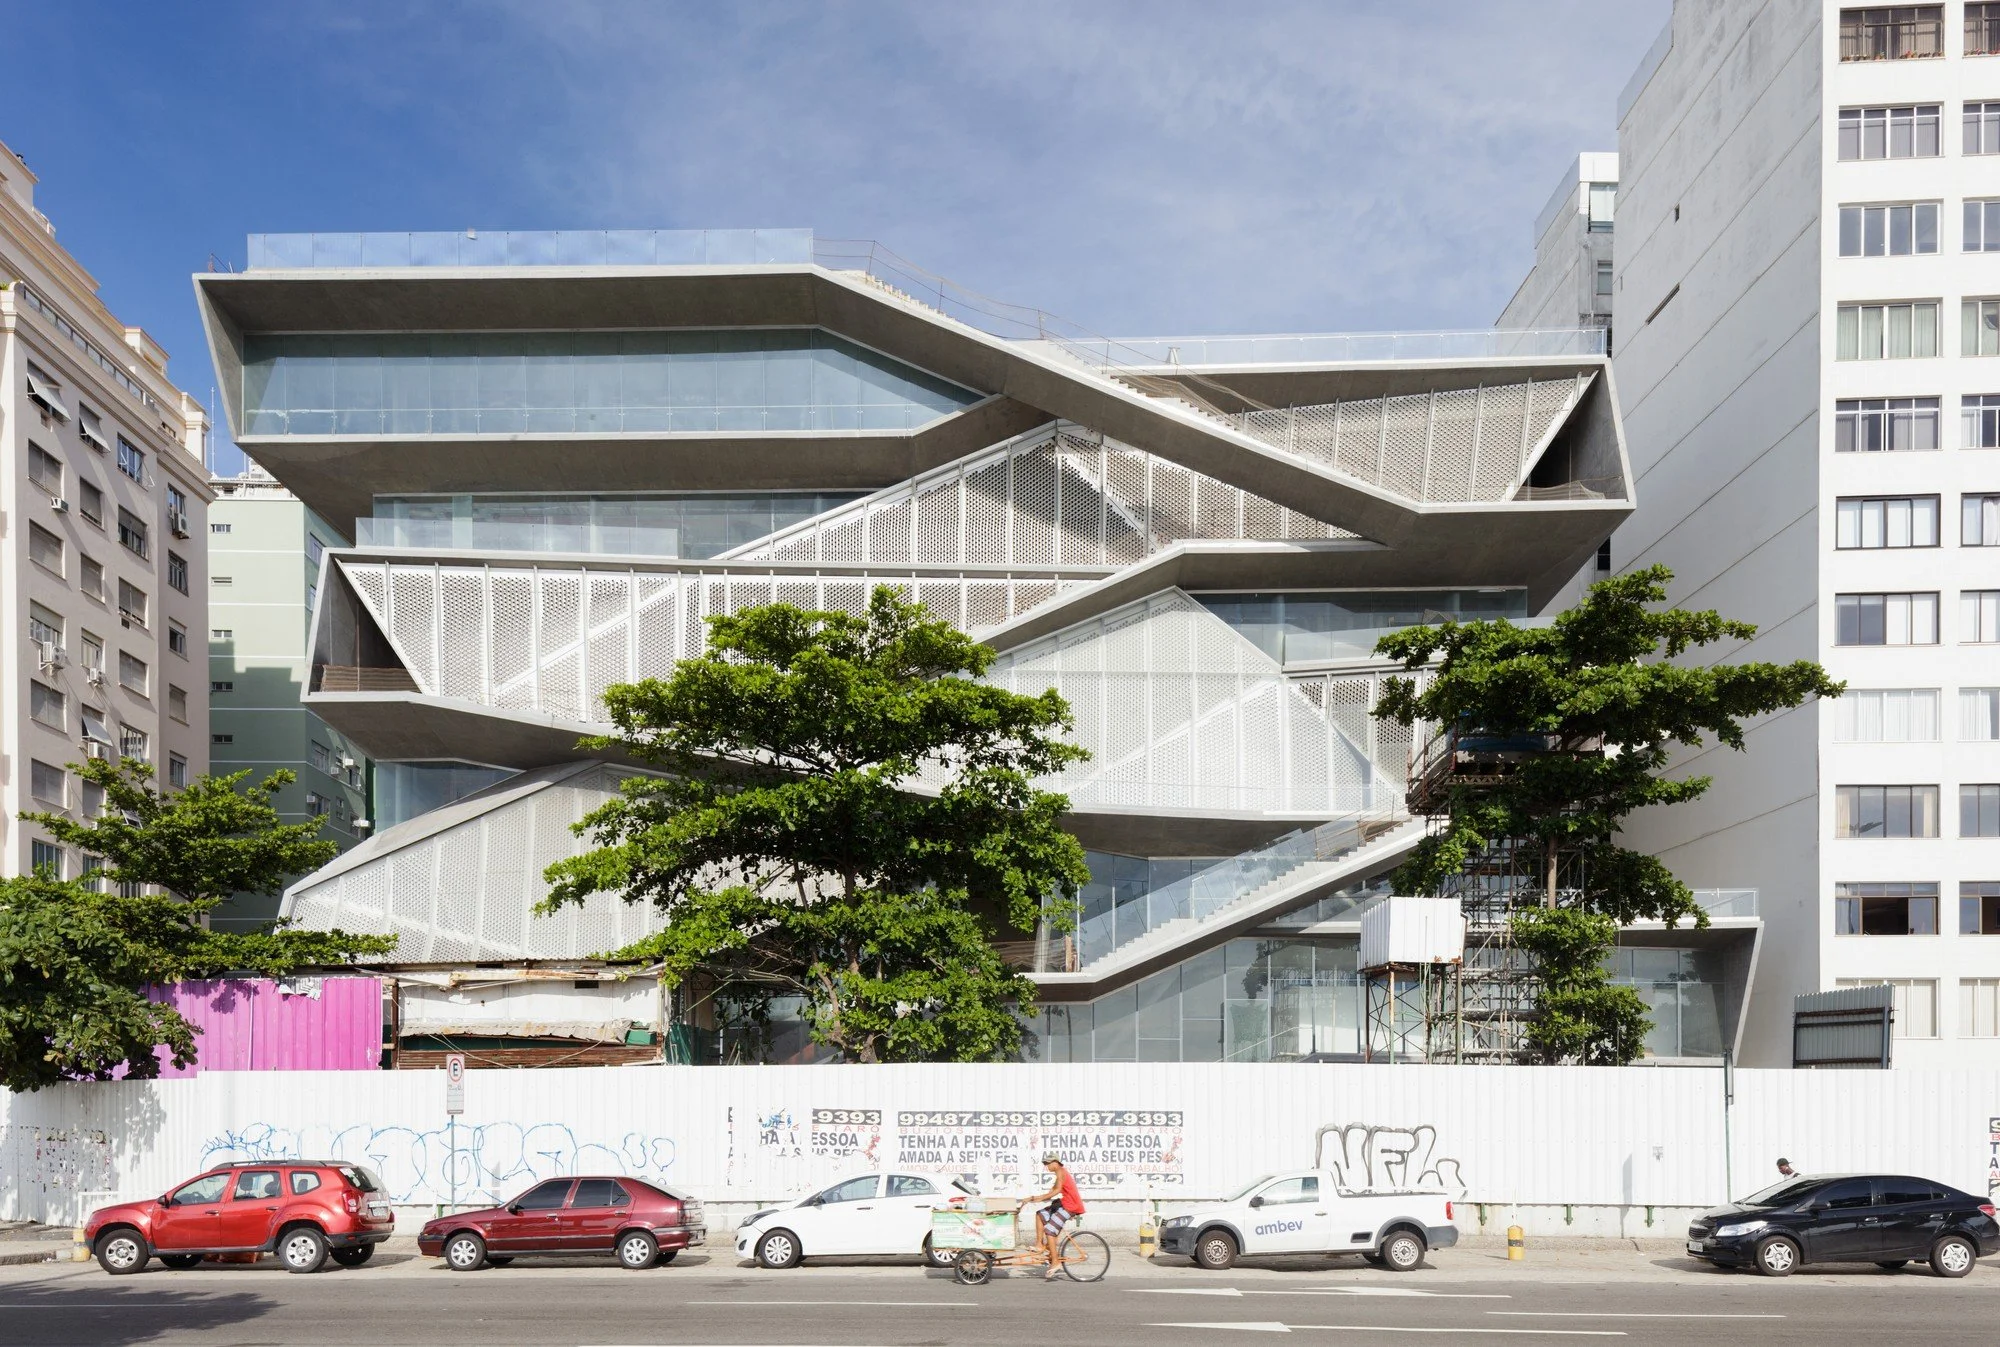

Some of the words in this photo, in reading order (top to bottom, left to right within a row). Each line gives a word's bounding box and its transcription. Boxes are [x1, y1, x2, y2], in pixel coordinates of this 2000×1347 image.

[899, 1113, 1038, 1126] 99487-9393
[1041, 1112, 1182, 1126] 99487-9393
[898, 1135, 946, 1149] TENHA
[950, 1135, 960, 1149] A
[964, 1135, 1019, 1149] PESSOA
[1041, 1134, 1088, 1149] TENHA
[1093, 1134, 1103, 1148] A
[1107, 1134, 1162, 1149] PESSOA
[898, 1151, 942, 1164] AMADA
[946, 1151, 955, 1164] A
[1088, 1151, 1098, 1163] A
[1102, 1150, 1135, 1164] SEUS
[1254, 1219, 1303, 1236] ambev
